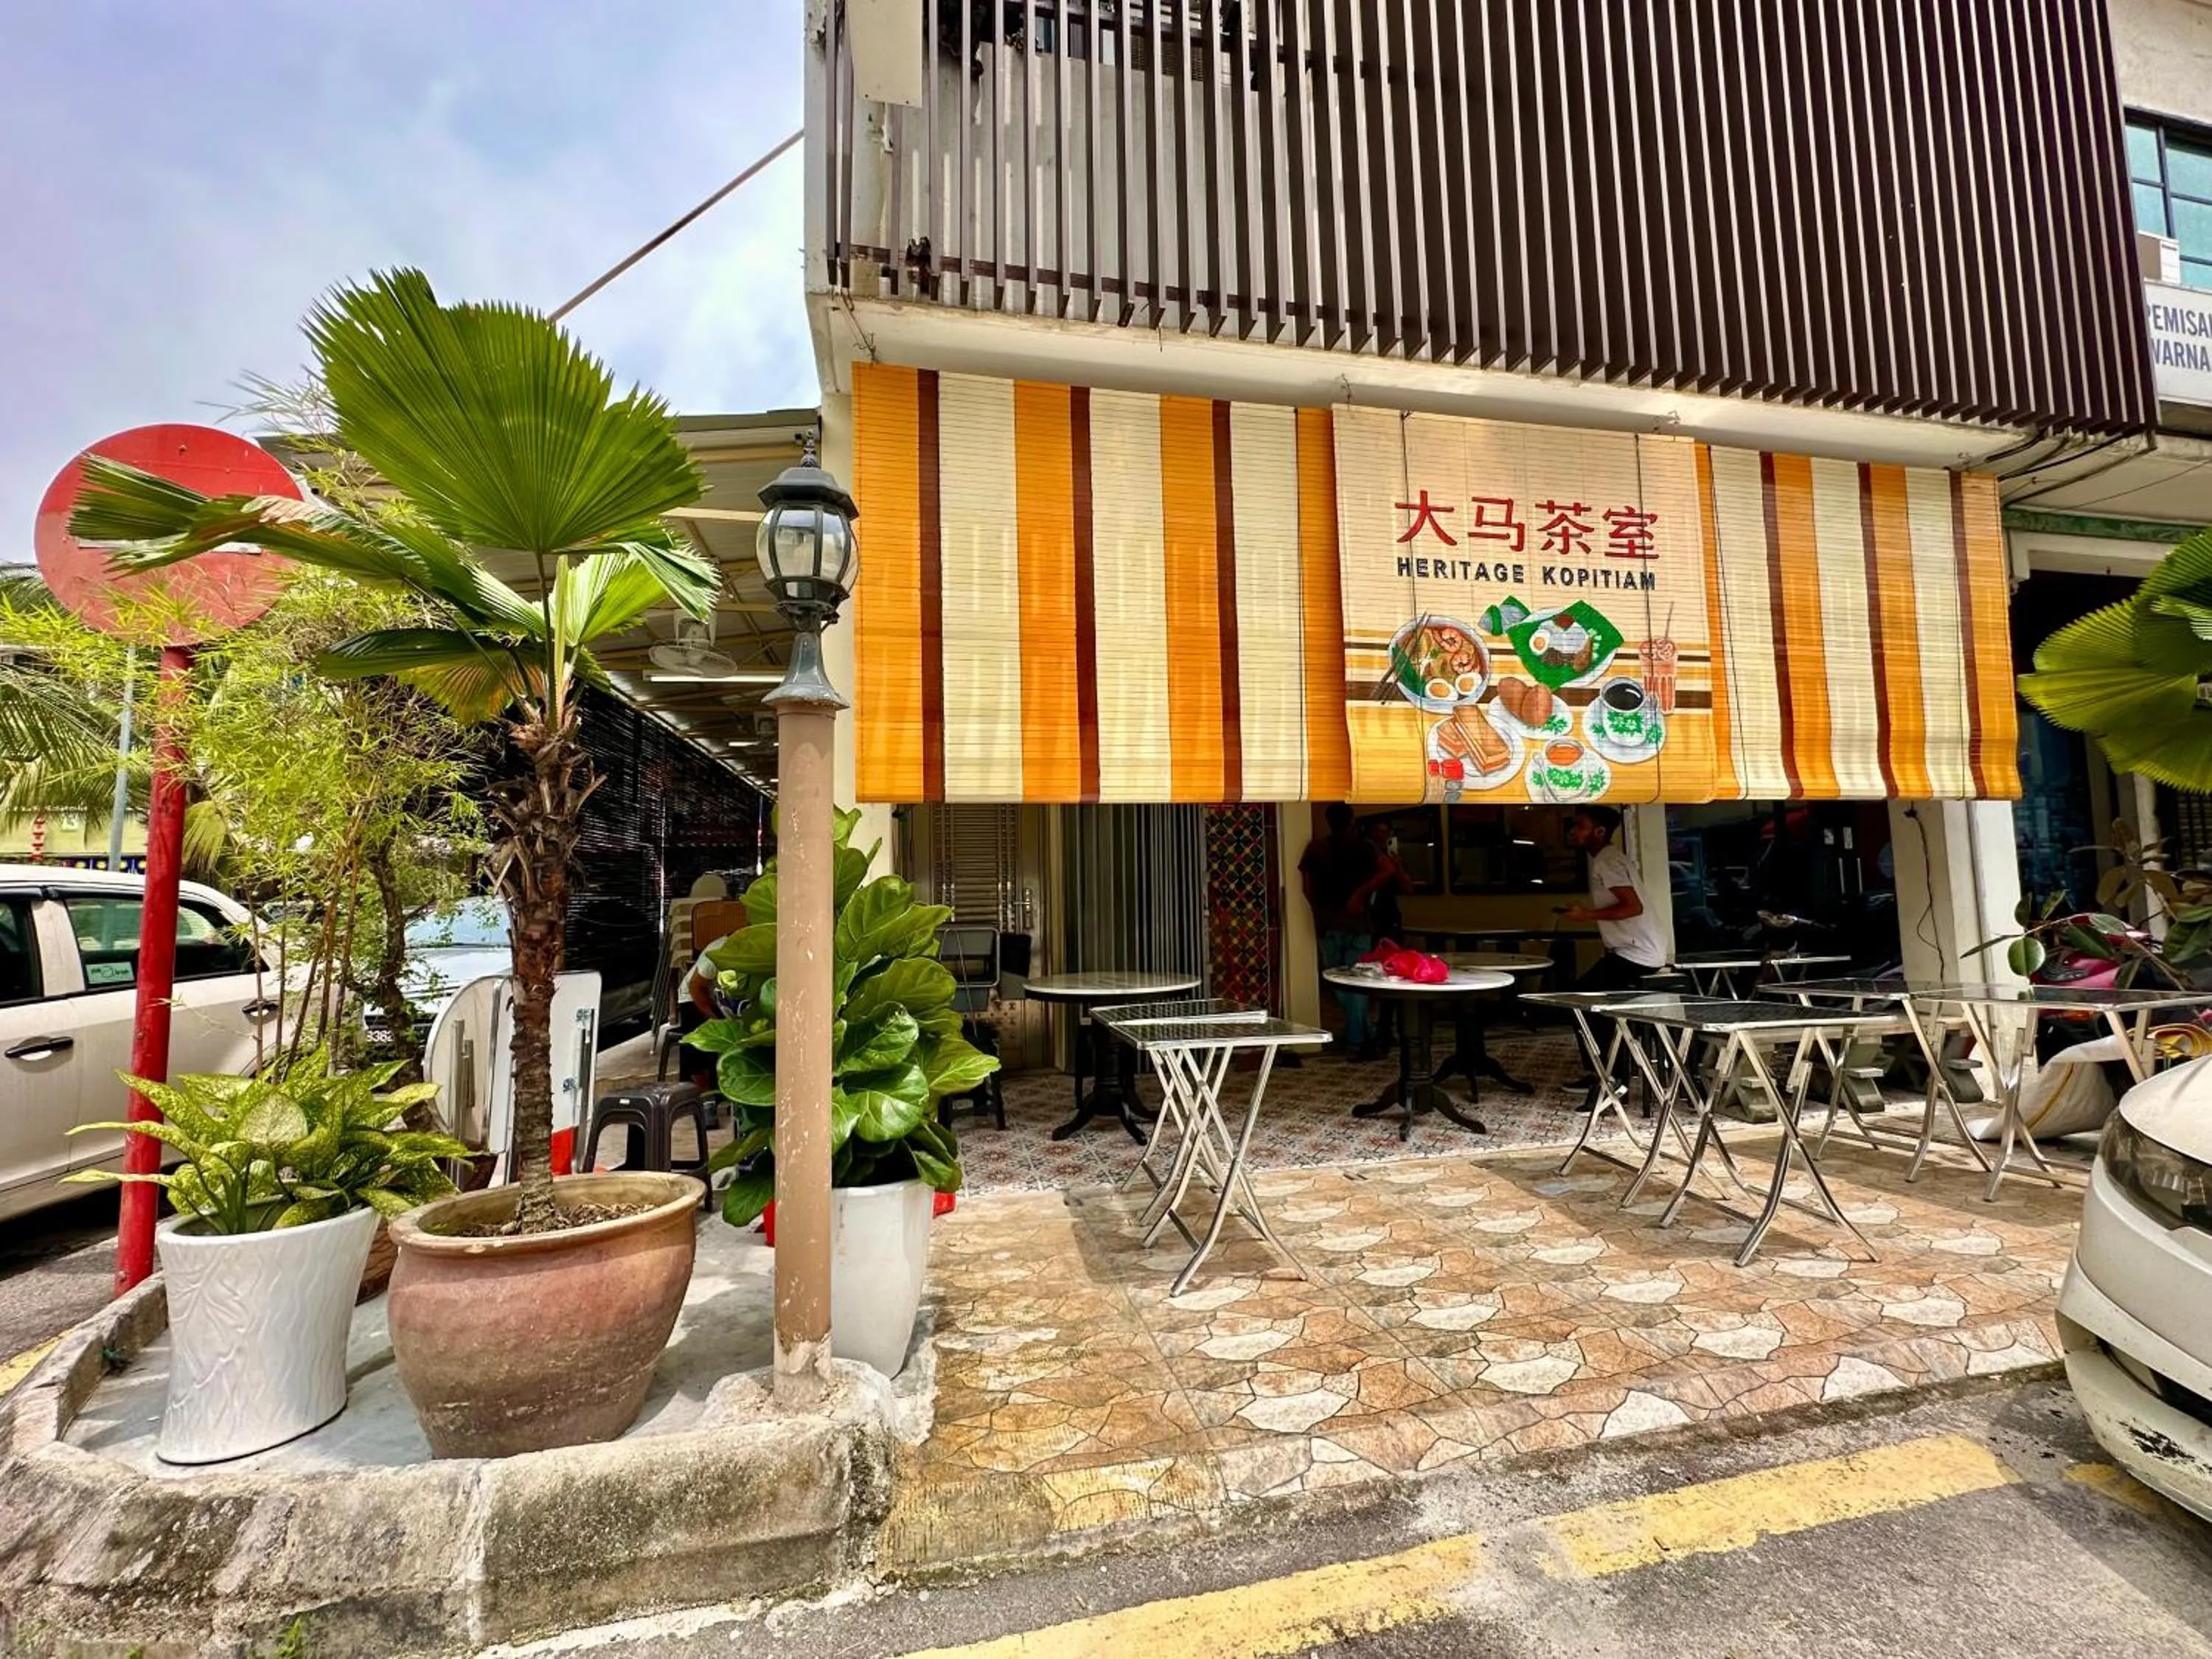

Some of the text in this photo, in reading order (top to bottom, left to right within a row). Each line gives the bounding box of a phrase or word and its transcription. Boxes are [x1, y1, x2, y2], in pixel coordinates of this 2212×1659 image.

[2147, 305, 2212, 338] EMISA
[1395, 490, 1659, 559] 大马茶室
[1397, 557, 1656, 591] HERITAGE KOPITIAM
